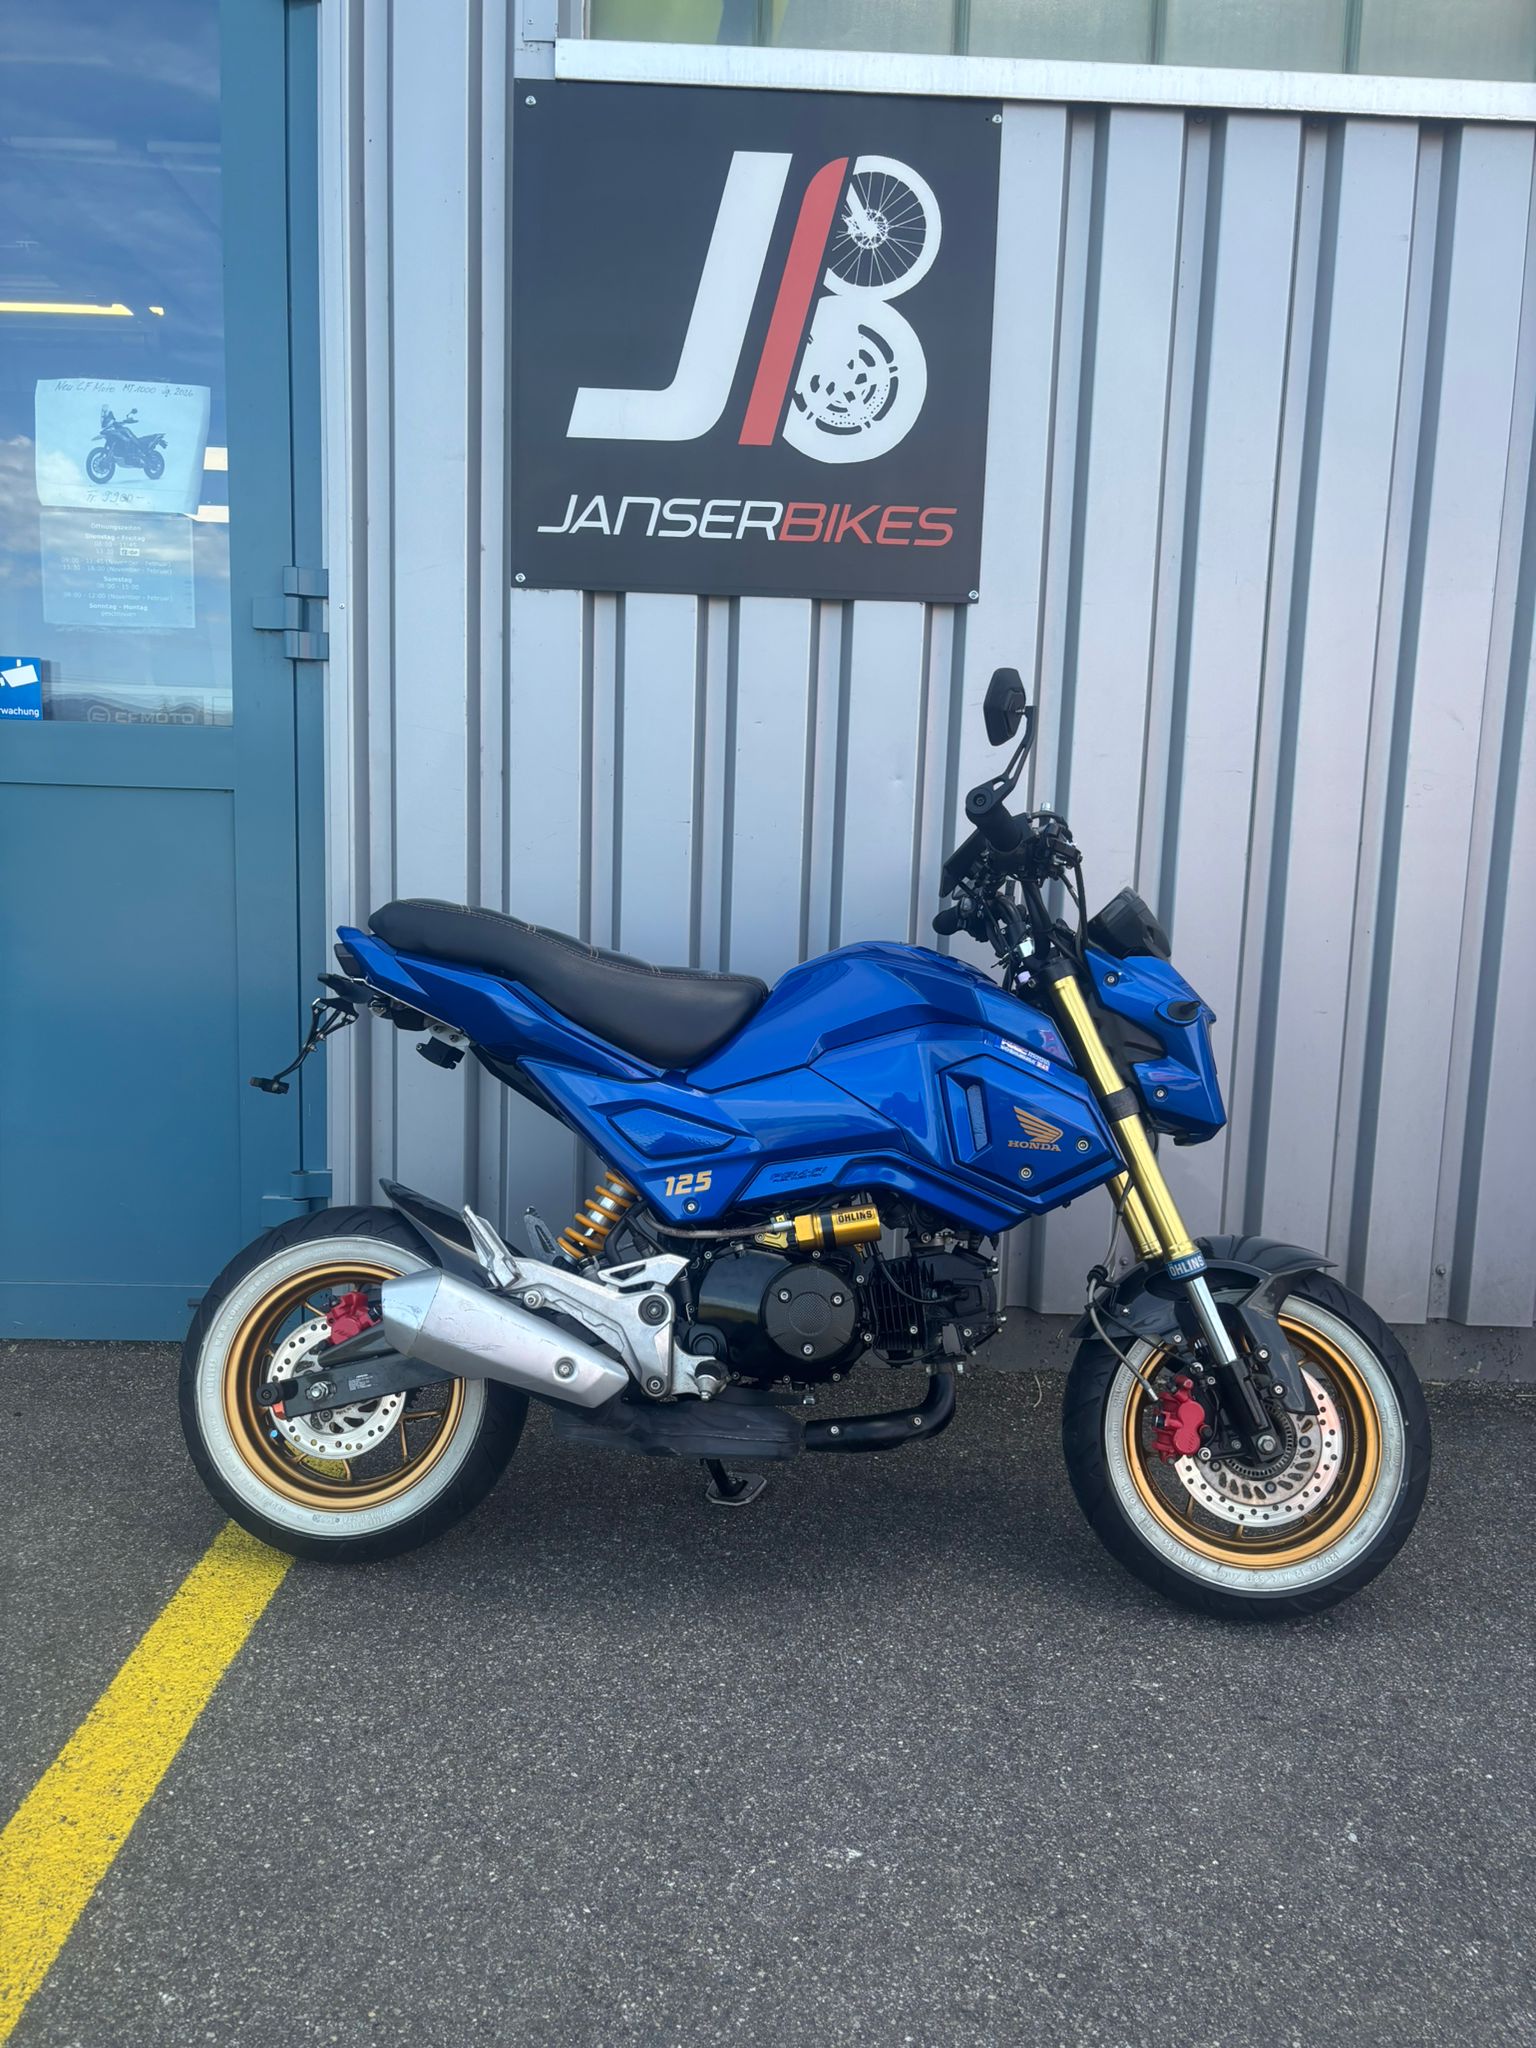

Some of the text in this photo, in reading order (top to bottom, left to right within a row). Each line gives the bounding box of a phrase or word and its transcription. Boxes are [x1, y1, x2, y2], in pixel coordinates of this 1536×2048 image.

[537, 494, 958, 547] JANSERBIKES
[104, 576, 132, 584] Samstag
[89, 603, 117, 611] Sonntag
[124, 603, 148, 611] Montag
[1007, 1139, 1062, 1152] HONDA
[665, 1170, 713, 1197] 125
[837, 1210, 874, 1225] ÖHLINS
[1169, 1255, 1206, 1278] ÖHLINS
